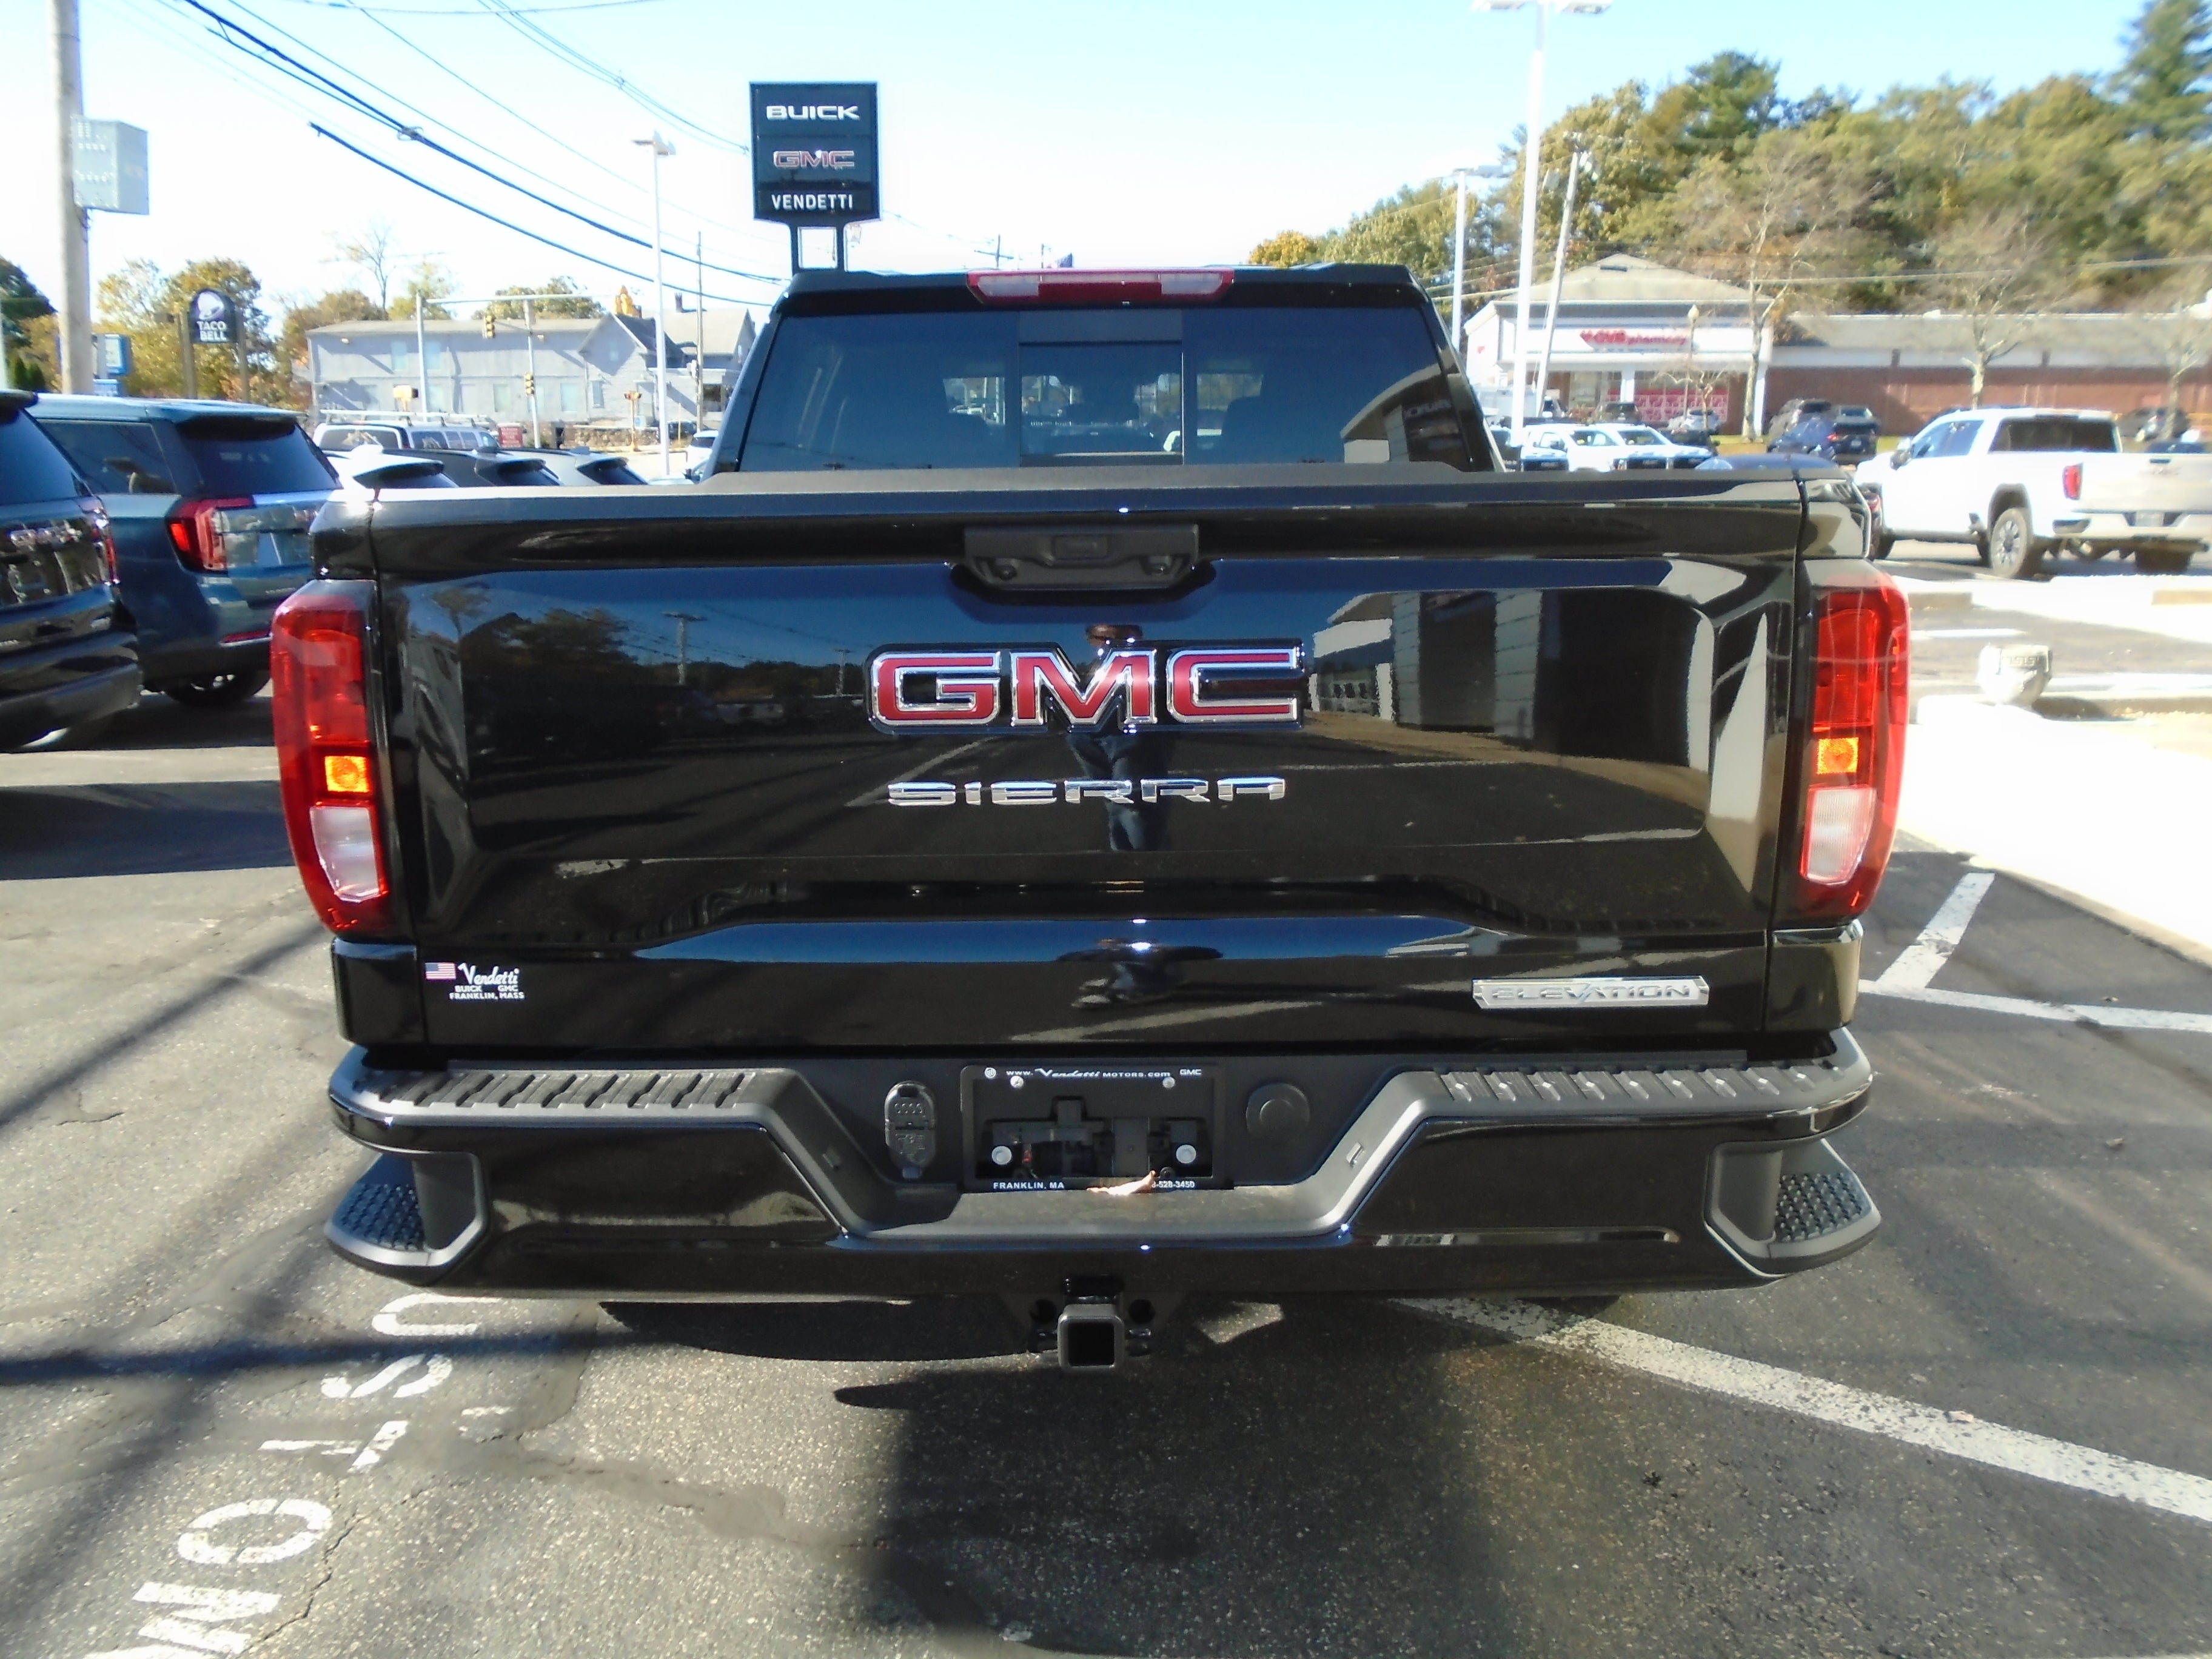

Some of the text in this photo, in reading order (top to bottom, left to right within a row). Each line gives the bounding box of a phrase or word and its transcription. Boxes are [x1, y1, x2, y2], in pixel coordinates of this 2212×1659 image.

[766, 105, 860, 121] BUICK
[773, 150, 855, 168] GMC
[771, 193, 853, 210] VENDETTI
[196, 321, 227, 331] TACO
[199, 330, 227, 341] BELL
[868, 646, 1301, 729] GMC
[888, 776, 1286, 806] SIERRA
[457, 962, 520, 985] Vendetti
[1492, 985, 1691, 1000] ELEVATION
